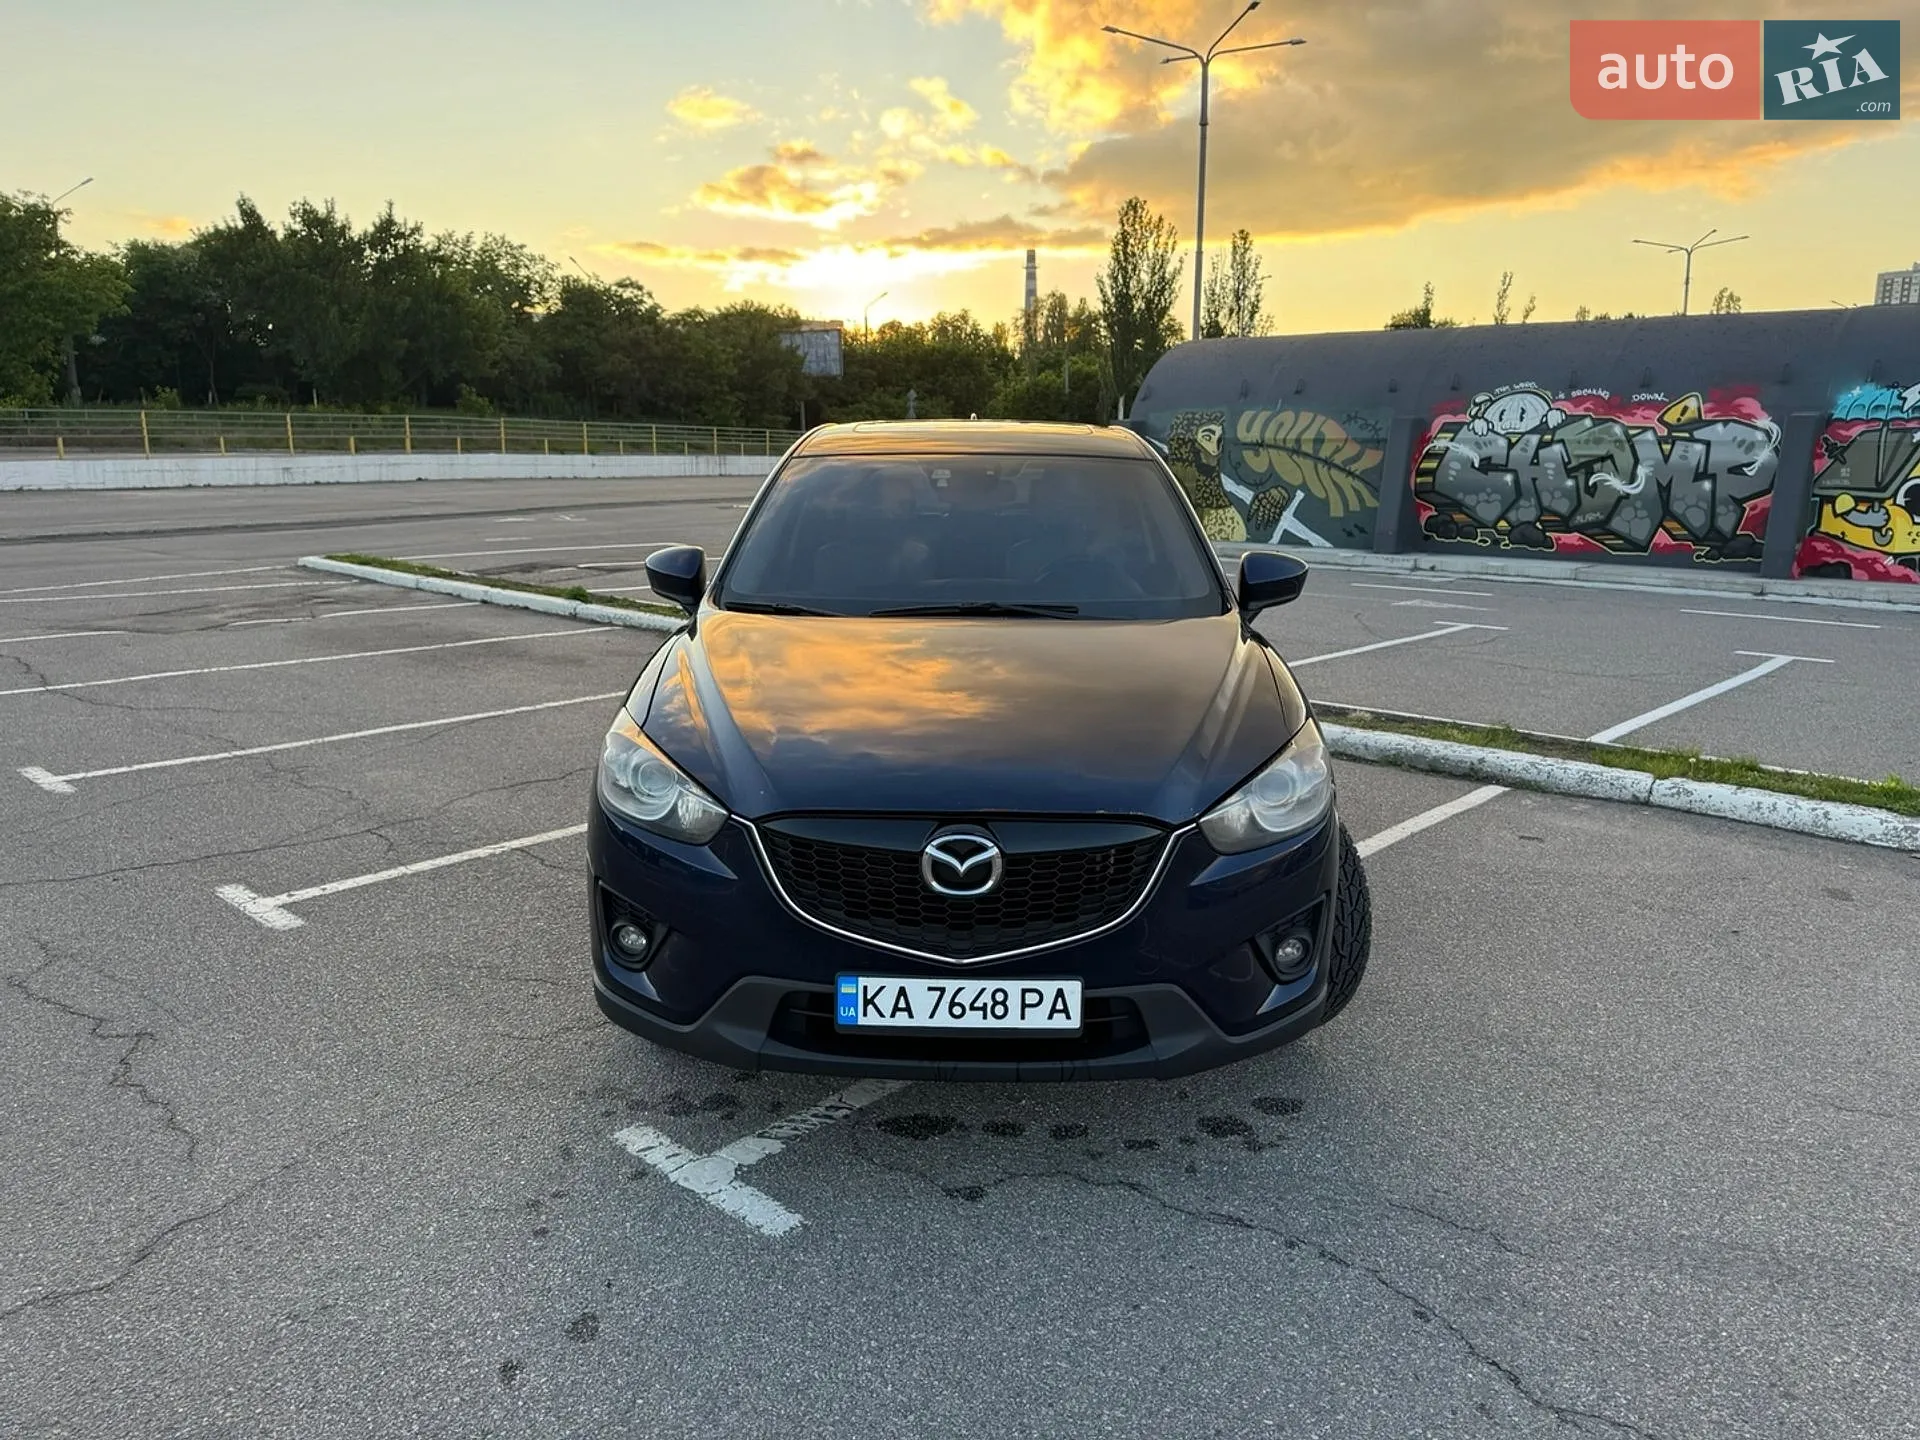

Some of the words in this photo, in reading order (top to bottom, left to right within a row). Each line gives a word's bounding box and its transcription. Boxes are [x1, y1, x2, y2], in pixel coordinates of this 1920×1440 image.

[840, 1006, 856, 1018] UA
[862, 985, 915, 1020] KA
[926, 986, 1010, 1021] 7648
[1020, 987, 1072, 1021] PA
